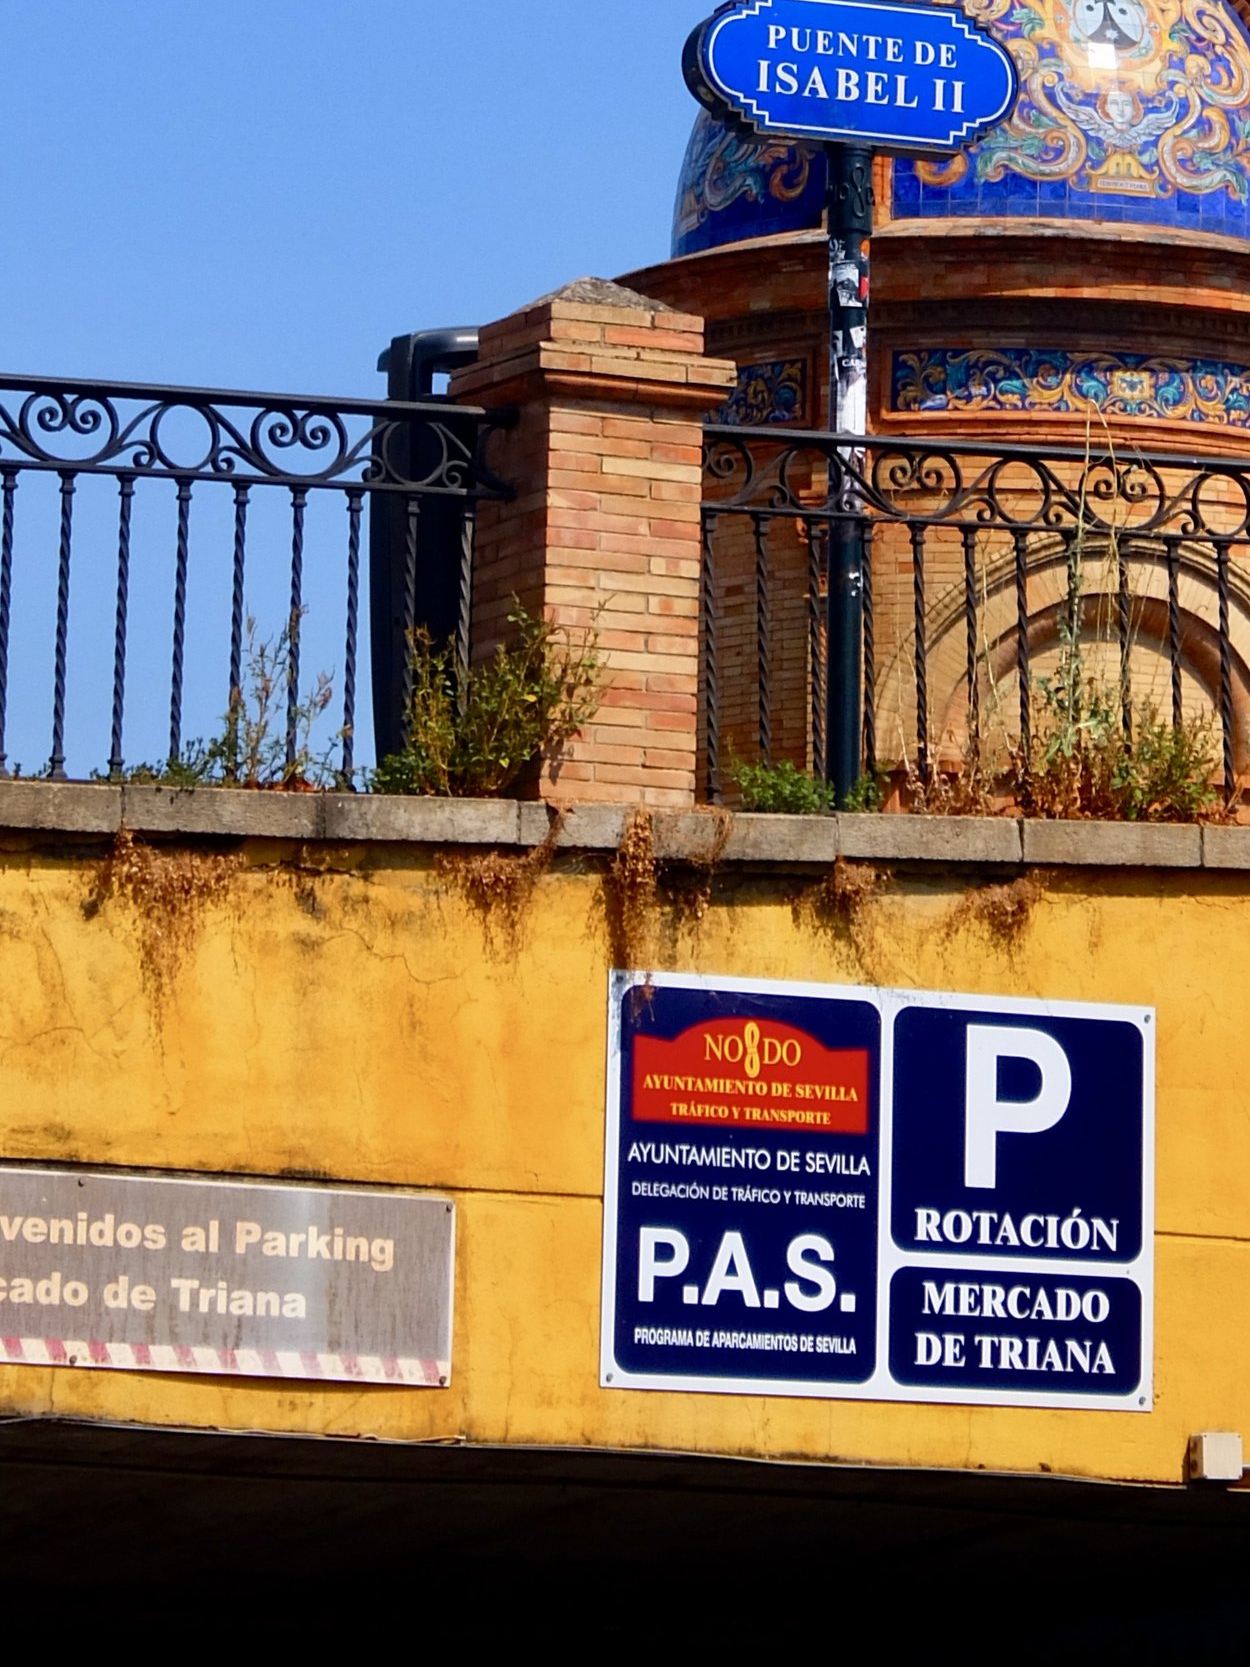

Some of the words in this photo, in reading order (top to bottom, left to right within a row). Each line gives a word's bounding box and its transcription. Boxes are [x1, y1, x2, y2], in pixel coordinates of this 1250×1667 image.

[767, 24, 904, 63] PUENTE
[914, 40, 958, 69] DE
[756, 60, 919, 109] ISABEL
[932, 78, 965, 113] II
[643, 1074, 768, 1097] AYUNTAMIENTO
[771, 1082, 792, 1098] DE
[795, 1085, 859, 1102] SEVILLA
[964, 1023, 1072, 1189] P
[670, 1101, 729, 1119] TRÁFICO
[731, 1107, 742, 1120] Y
[744, 1107, 832, 1125] TRANSPORTE
[627, 1142, 772, 1171] AYUNTAMIENTO
[776, 1151, 801, 1172] DE
[805, 1152, 871, 1176] SEVILLA
[631, 1181, 710, 1200] DELEGACIÓN
[712, 1186, 729, 1202] DE
[731, 1185, 781, 1204] TRÁFICO
[783, 1191, 793, 1205] Y
[794, 1191, 866, 1209] TRANSPORTE
[0, 1212, 166, 1250] venidos
[181, 1220, 219, 1253] al
[235, 1221, 395, 1272] Parking
[914, 1207, 1120, 1252] ROTACIÓN
[637, 1226, 857, 1313] P.A.S.
[103, 1275, 157, 1311] de
[170, 1277, 307, 1318] Triana
[922, 1280, 1110, 1323] MERCADO
[634, 1327, 694, 1347] PROGRAMA
[695, 1331, 710, 1348] DE
[711, 1332, 798, 1352] APARCAMIENTOS
[800, 1336, 814, 1353] DE
[815, 1336, 857, 1355] SEVILLA
[914, 1332, 967, 1367] DE
[974, 1335, 1116, 1375] TRIANA
